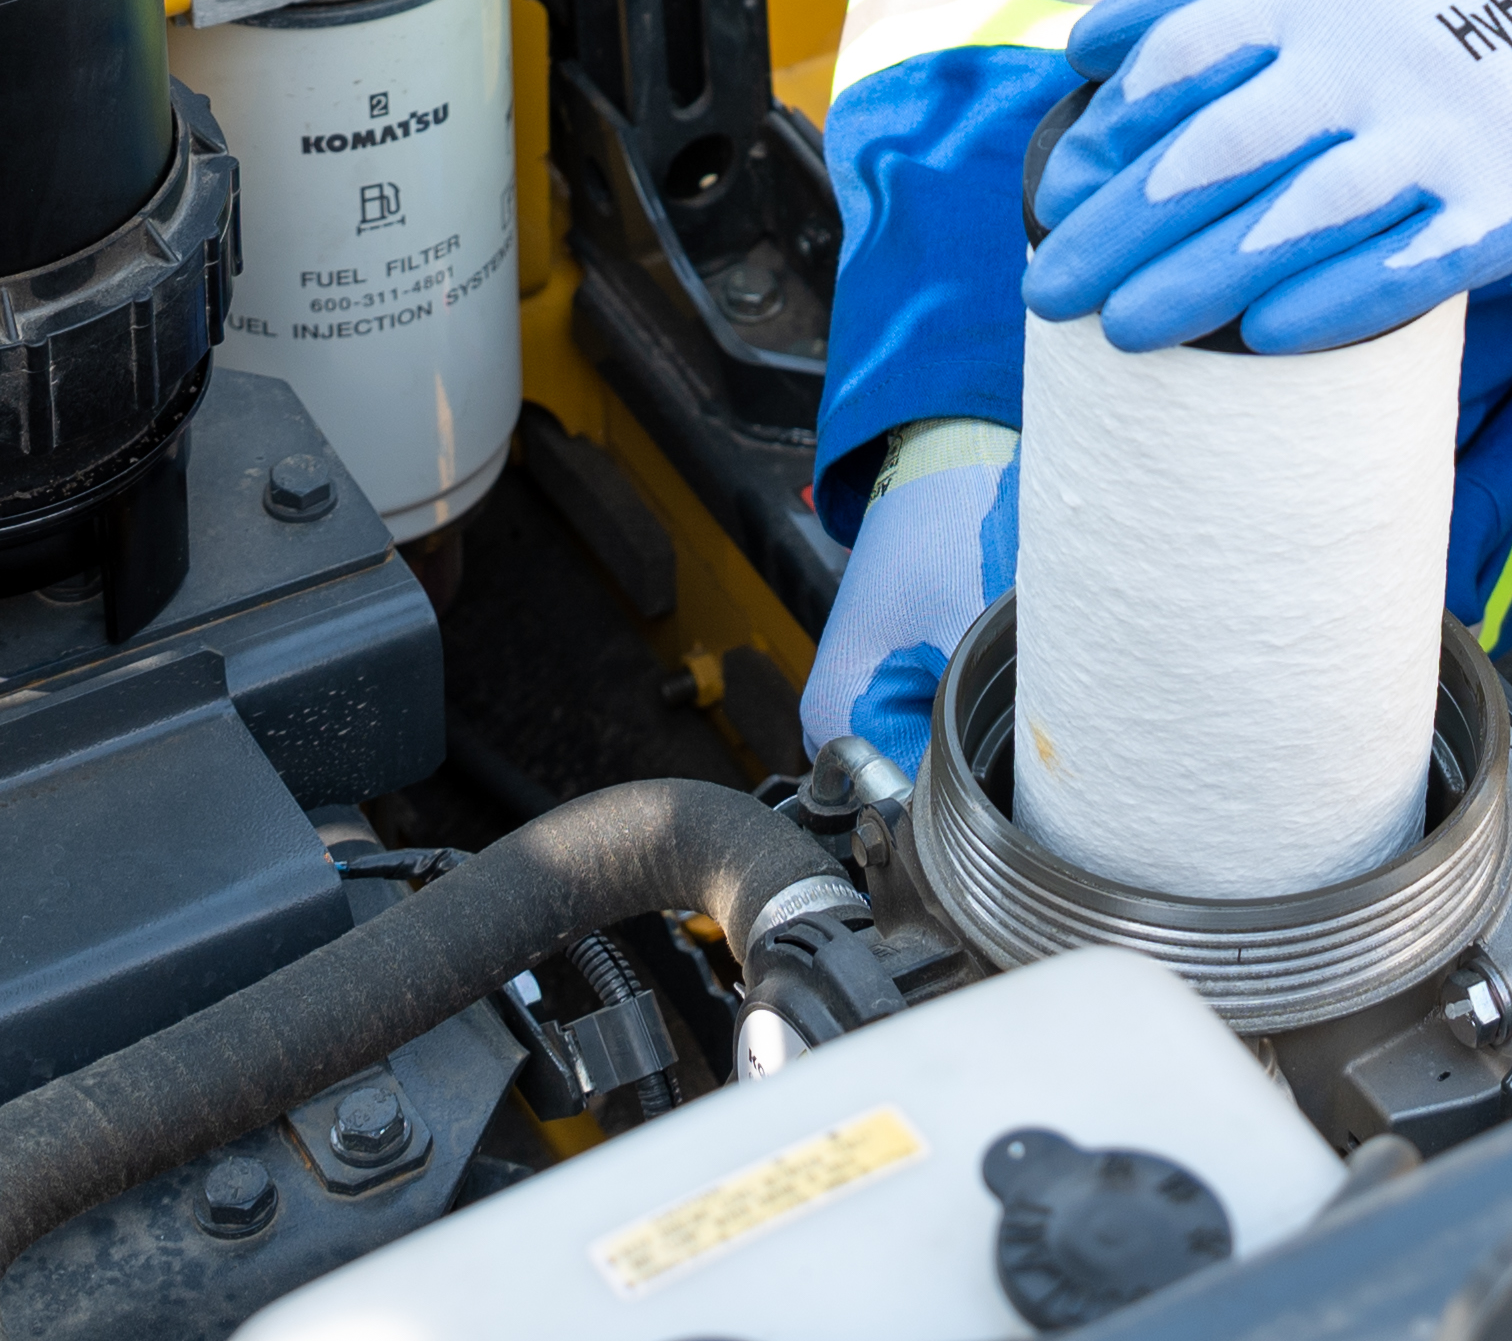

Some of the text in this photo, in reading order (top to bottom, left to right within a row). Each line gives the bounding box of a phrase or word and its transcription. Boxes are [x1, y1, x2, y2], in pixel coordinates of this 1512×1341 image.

[300, 102, 450, 155] KOMATSU
[300, 234, 461, 289] FUEL FILTER
[227, 314, 278, 338] UEL
[292, 301, 434, 340] INJECTION
